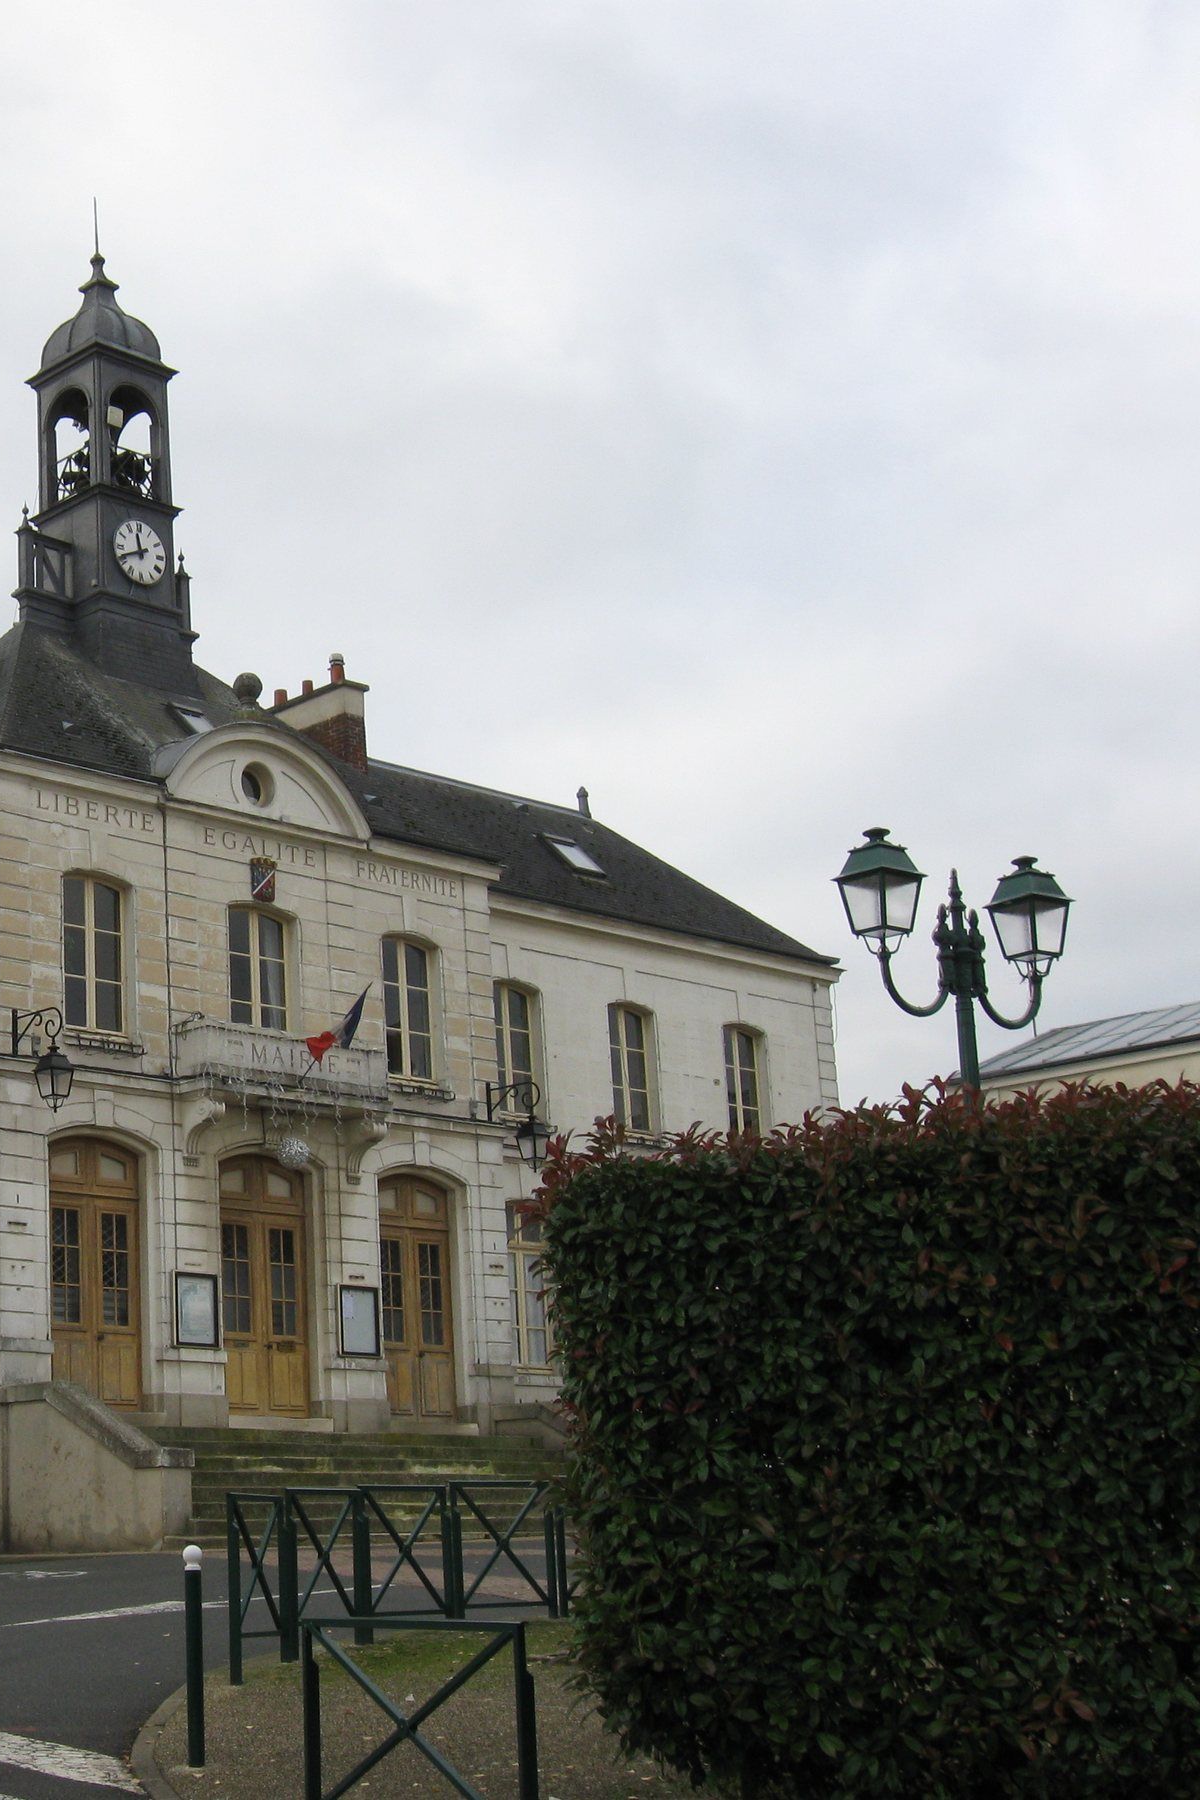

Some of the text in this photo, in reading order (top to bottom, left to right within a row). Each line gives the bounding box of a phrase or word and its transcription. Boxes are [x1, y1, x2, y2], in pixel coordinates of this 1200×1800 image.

[35, 789, 155, 832] LIBERTE
[203, 826, 317, 868] EGALITE
[356, 859, 458, 899] FRATERNITE
